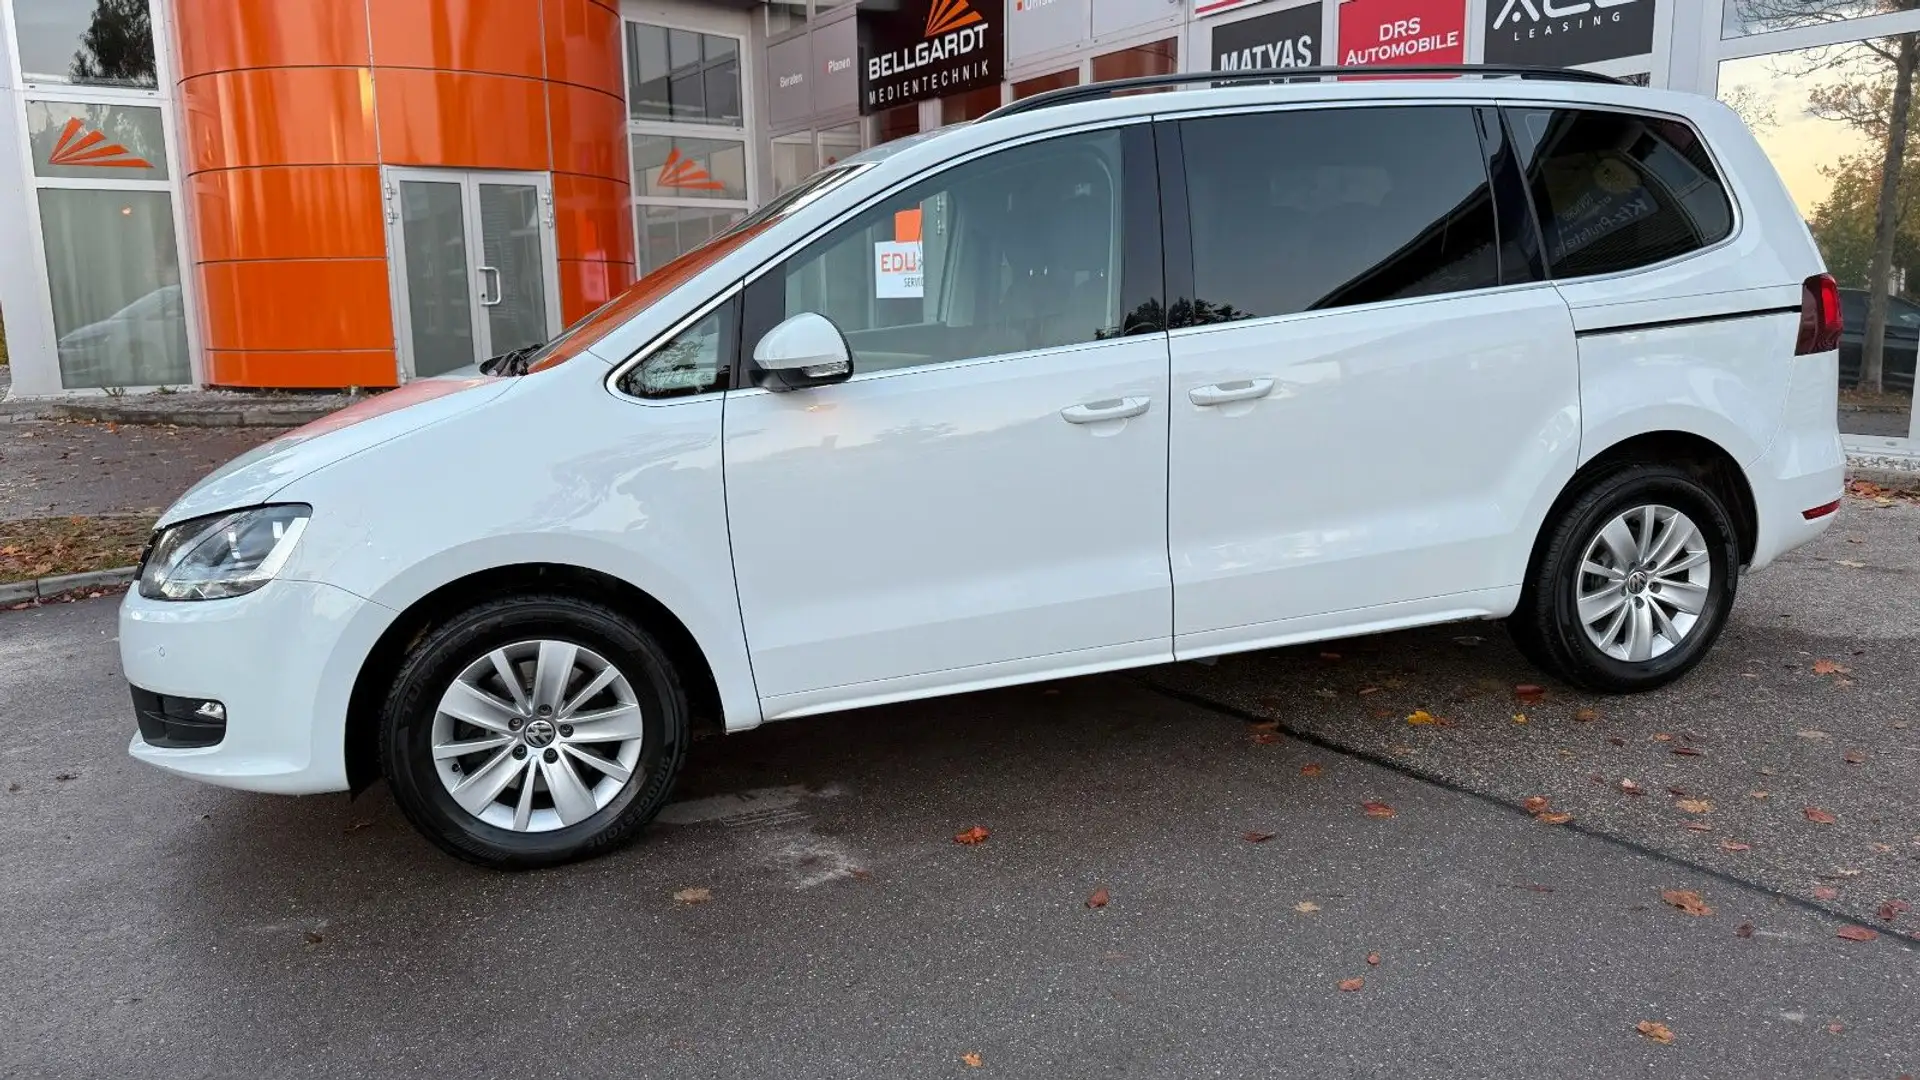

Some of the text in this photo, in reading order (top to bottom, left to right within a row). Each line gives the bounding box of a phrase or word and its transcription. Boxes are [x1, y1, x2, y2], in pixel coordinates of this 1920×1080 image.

[1379, 17, 1421, 41] DRS
[1513, 11, 1621, 42] LEASING
[868, 23, 989, 81] BELLGARDT
[1220, 35, 1312, 71] MATYAS
[1344, 31, 1460, 66] AUTOMOBILE
[868, 59, 989, 105] MEDIENTECHNIK
